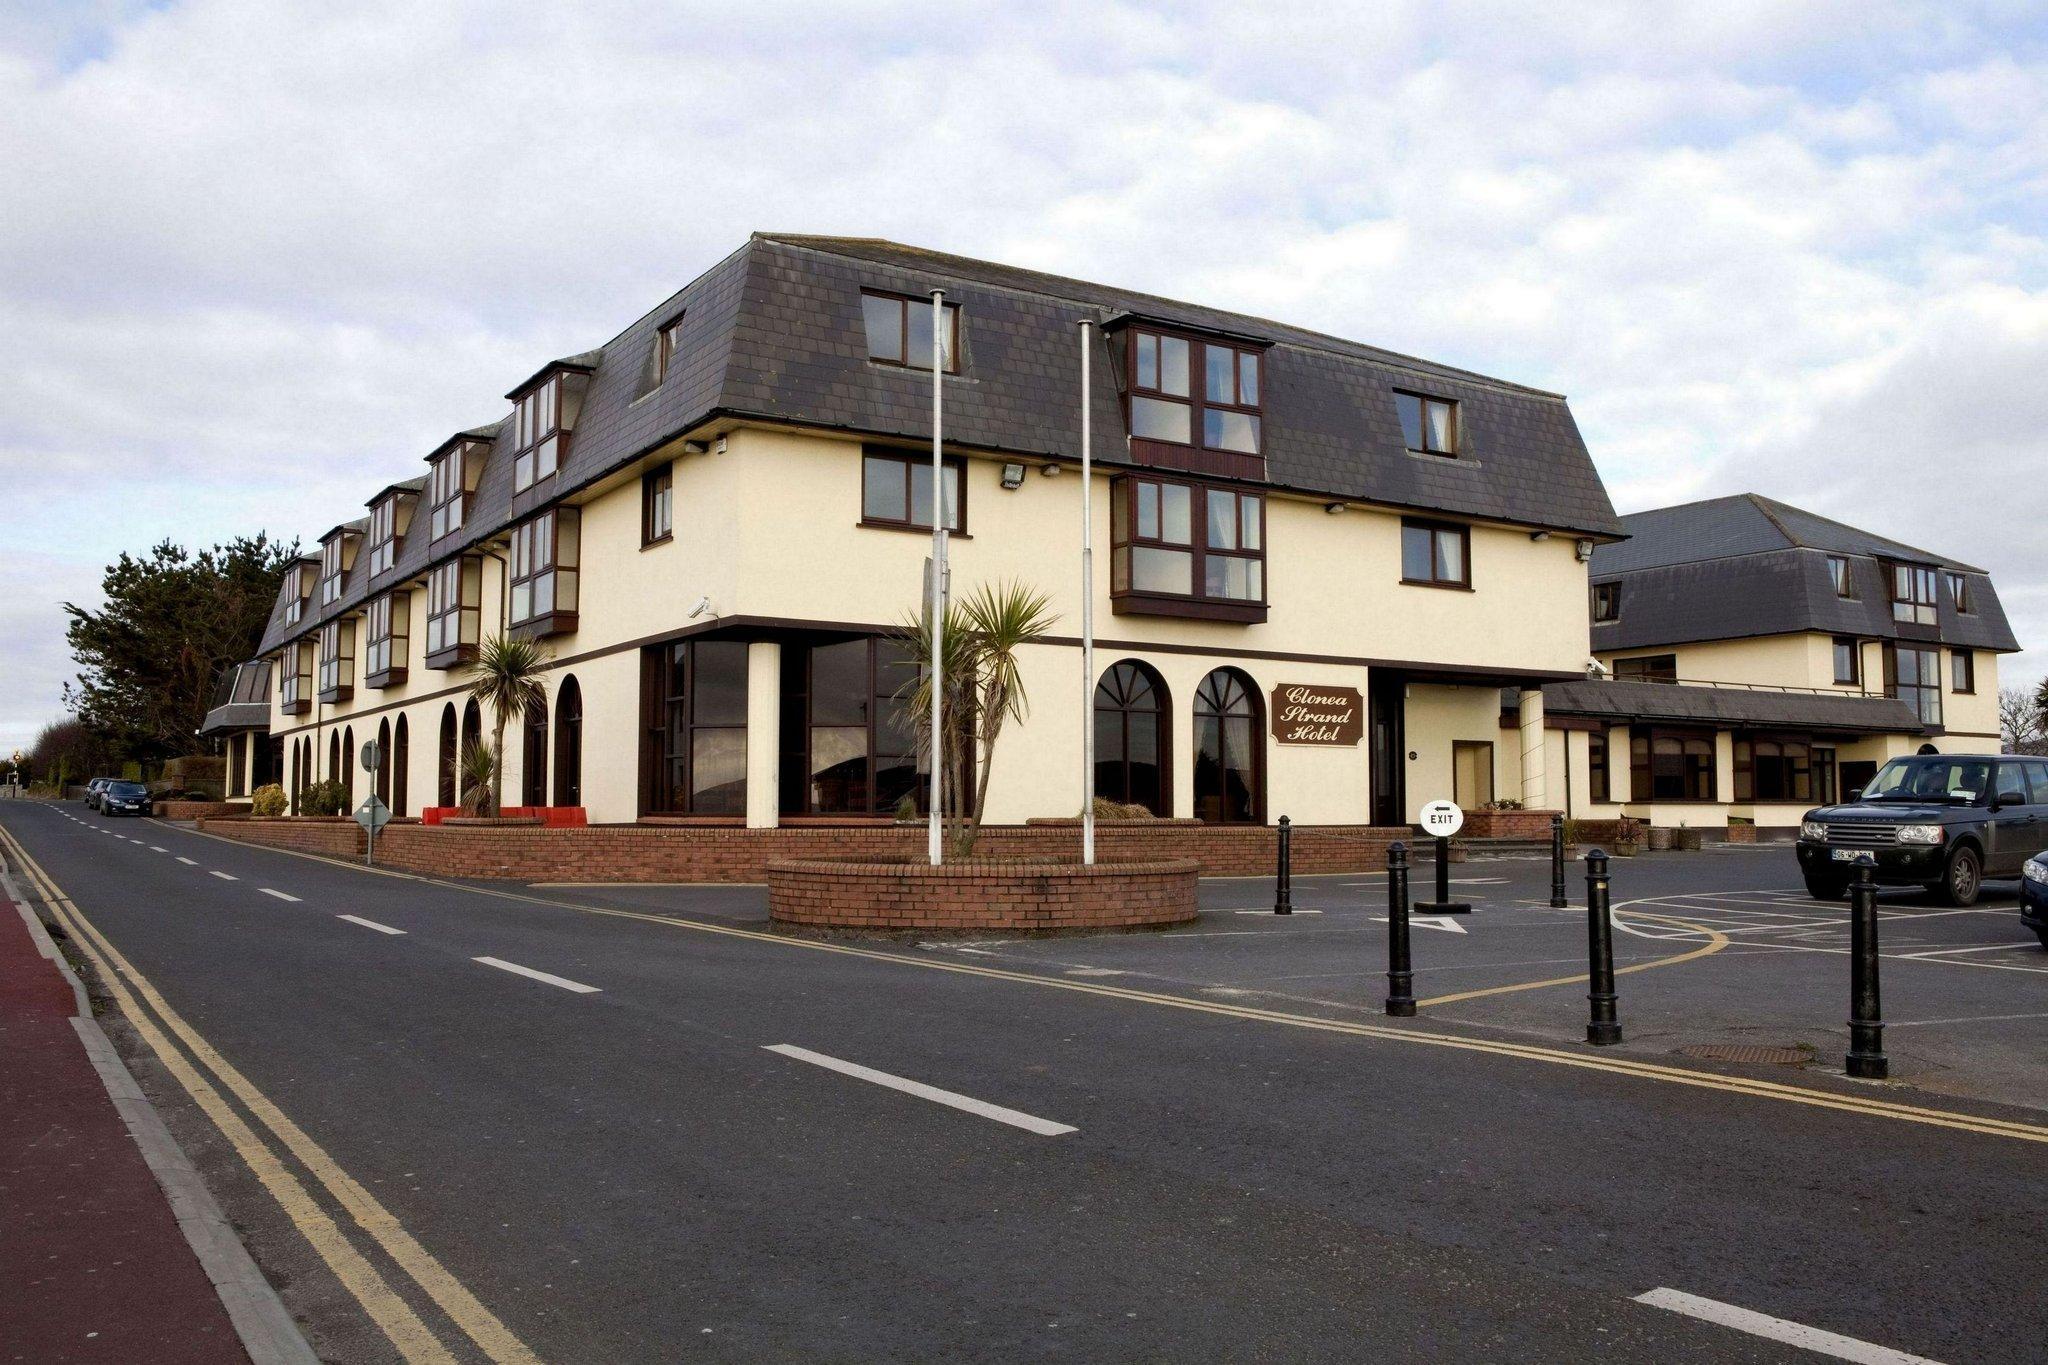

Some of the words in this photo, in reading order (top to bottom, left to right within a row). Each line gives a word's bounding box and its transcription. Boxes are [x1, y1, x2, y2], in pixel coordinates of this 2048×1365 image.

[1286, 687, 1348, 706] Clonea
[1280, 706, 1353, 723] Strand
[1287, 725, 1341, 741] Hotel
[1430, 815, 1453, 824] EXIT
